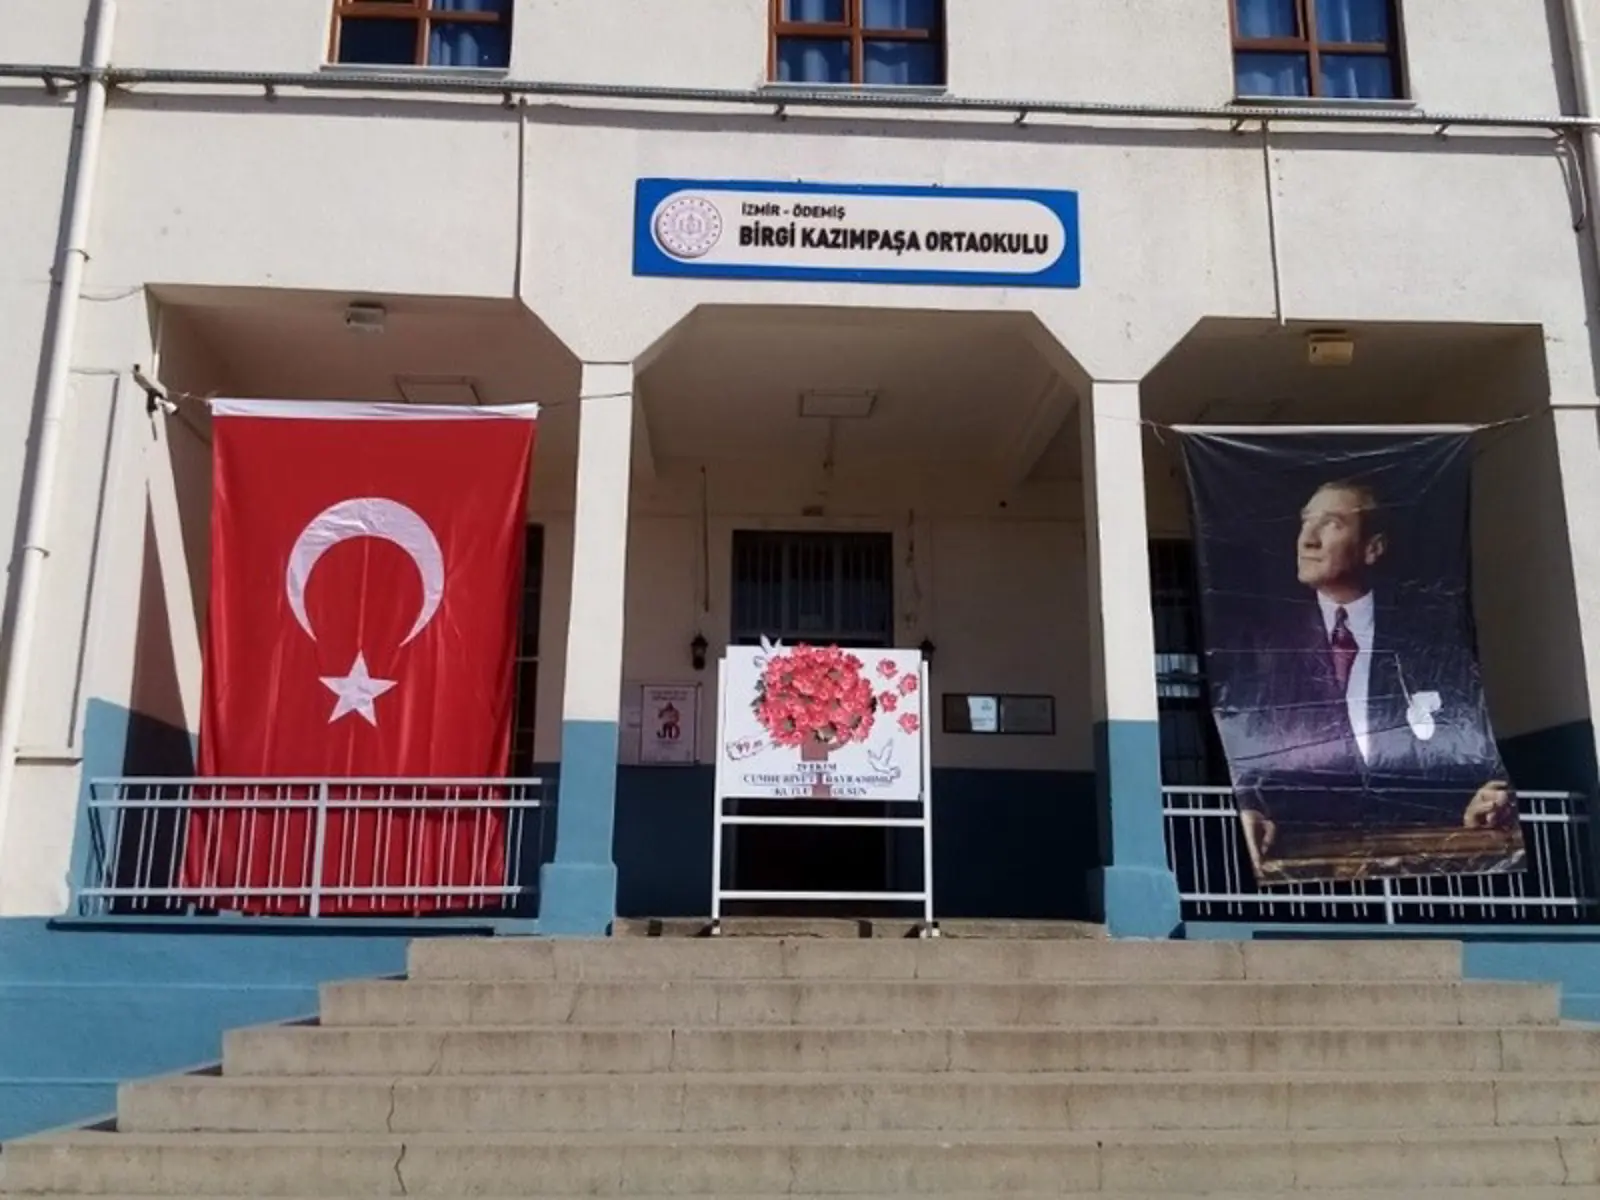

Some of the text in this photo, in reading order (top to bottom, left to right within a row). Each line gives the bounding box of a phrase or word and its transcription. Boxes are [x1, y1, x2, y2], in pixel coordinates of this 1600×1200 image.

[741, 202, 780, 216] İZMİR
[792, 203, 846, 221] ÖDEMİŞ
[739, 220, 1049, 256] BİRGİ KAZIMPAŞA ORTAOKULU
